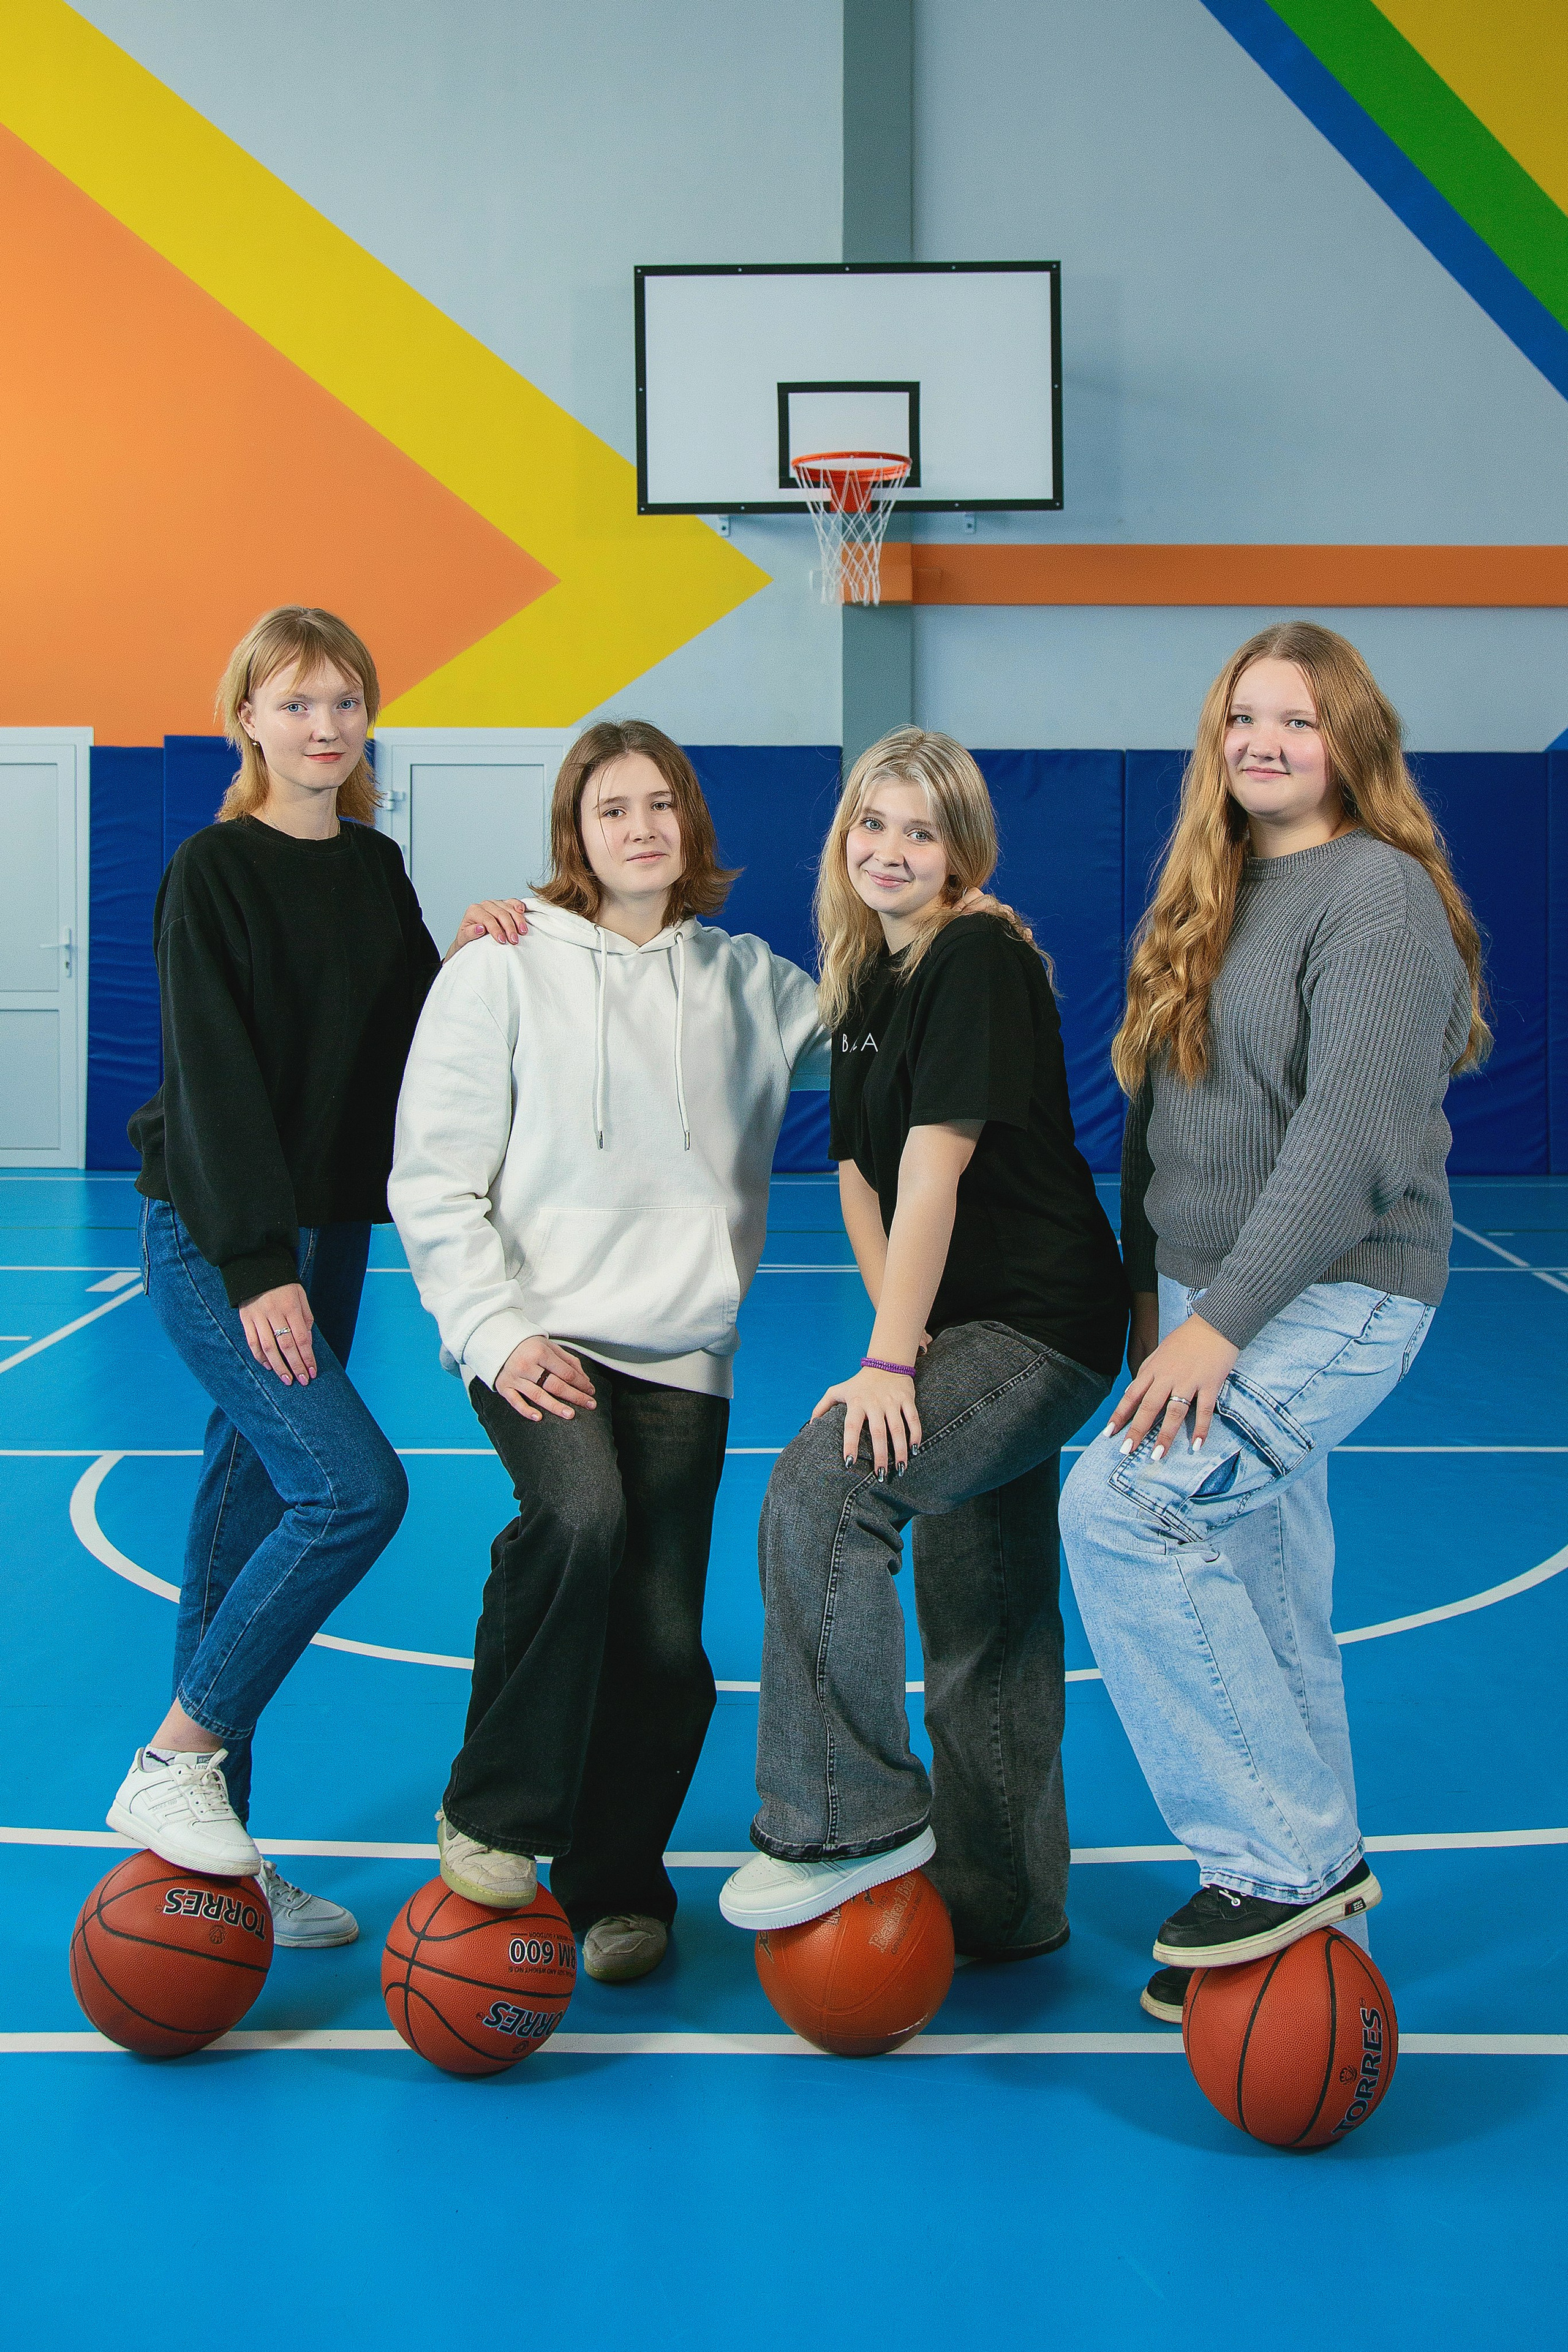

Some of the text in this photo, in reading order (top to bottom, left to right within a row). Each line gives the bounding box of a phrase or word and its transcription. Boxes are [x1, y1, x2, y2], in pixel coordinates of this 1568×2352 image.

[163, 1887, 266, 1942] TORRES
[508, 1938, 555, 1965] 600
[1331, 2007, 1383, 2135] TORRES
